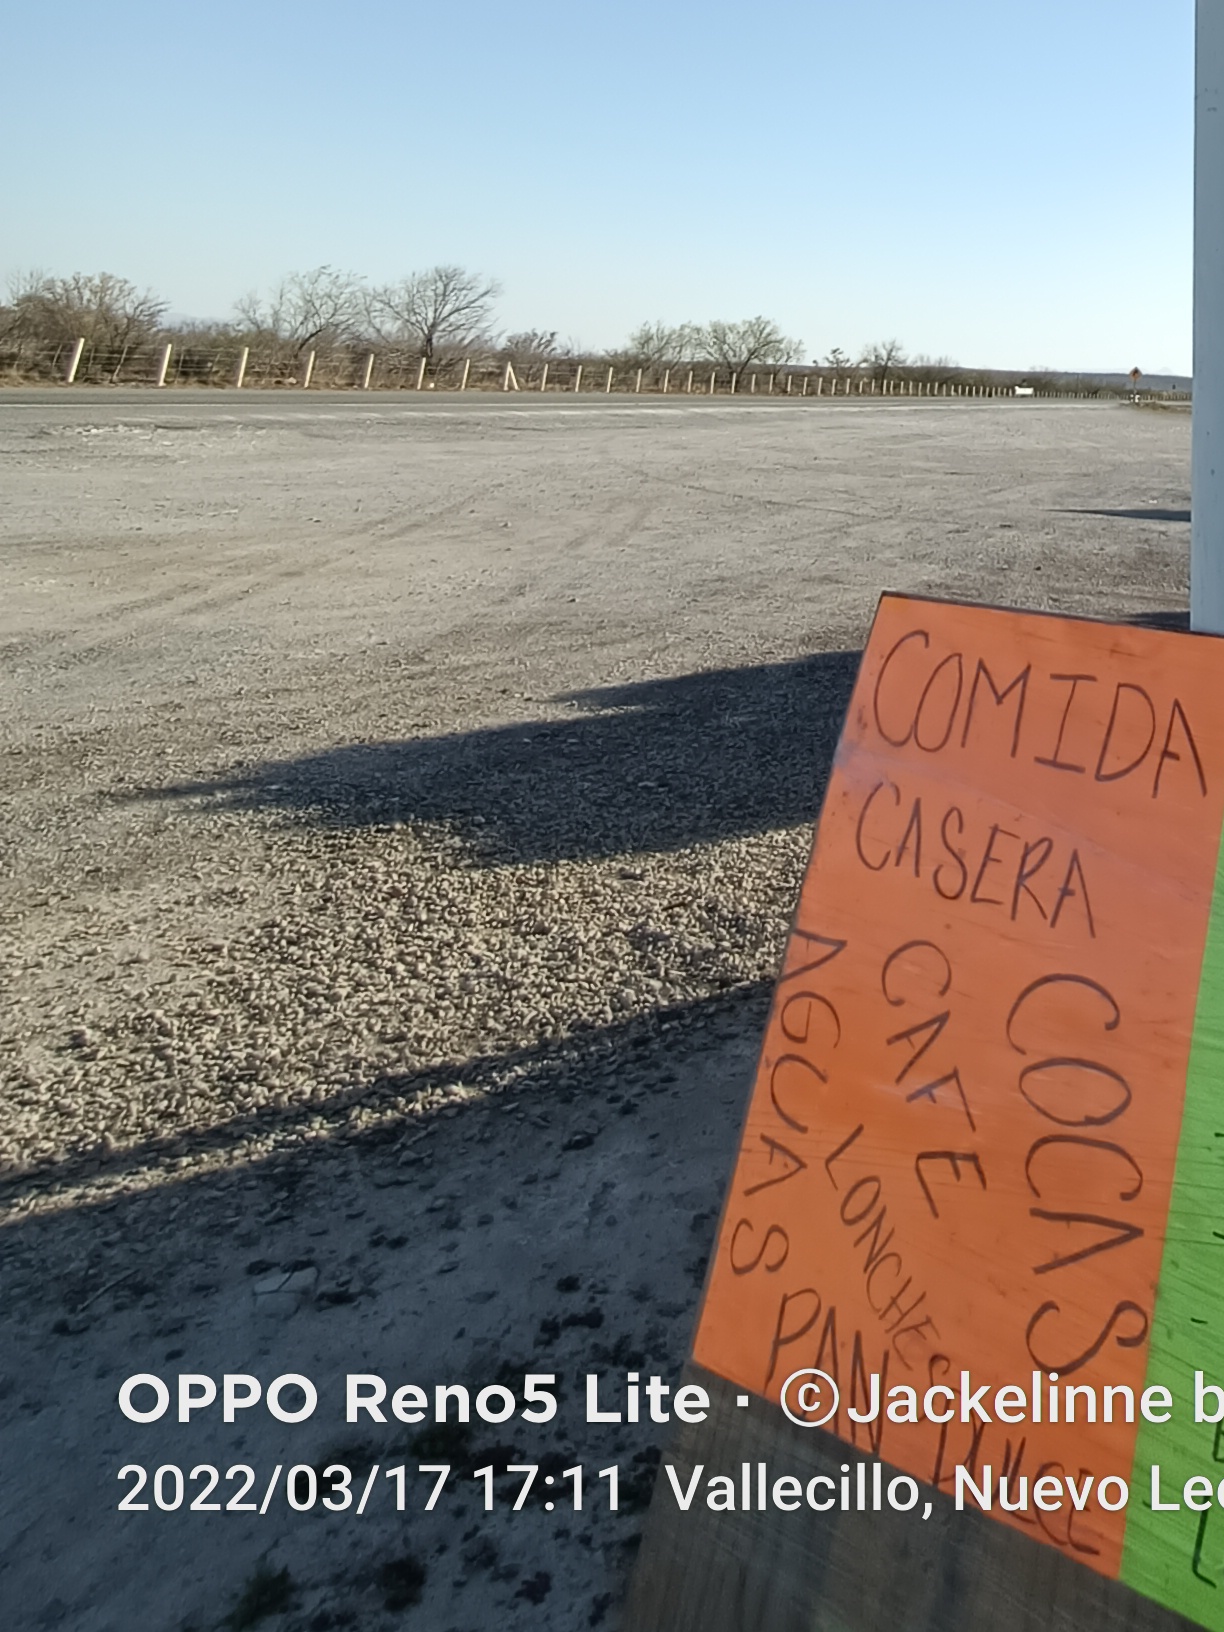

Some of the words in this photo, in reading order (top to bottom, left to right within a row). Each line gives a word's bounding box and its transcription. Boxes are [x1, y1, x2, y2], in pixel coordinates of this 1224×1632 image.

[872, 629, 1208, 799] COMIDA
[855, 780, 1097, 939] CASERA
[729, 927, 848, 1276] AGUAS
[881, 938, 988, 1220] CAFE
[1006, 973, 1149, 1377] COCAS
[763, 1287, 890, 1460] PAN
